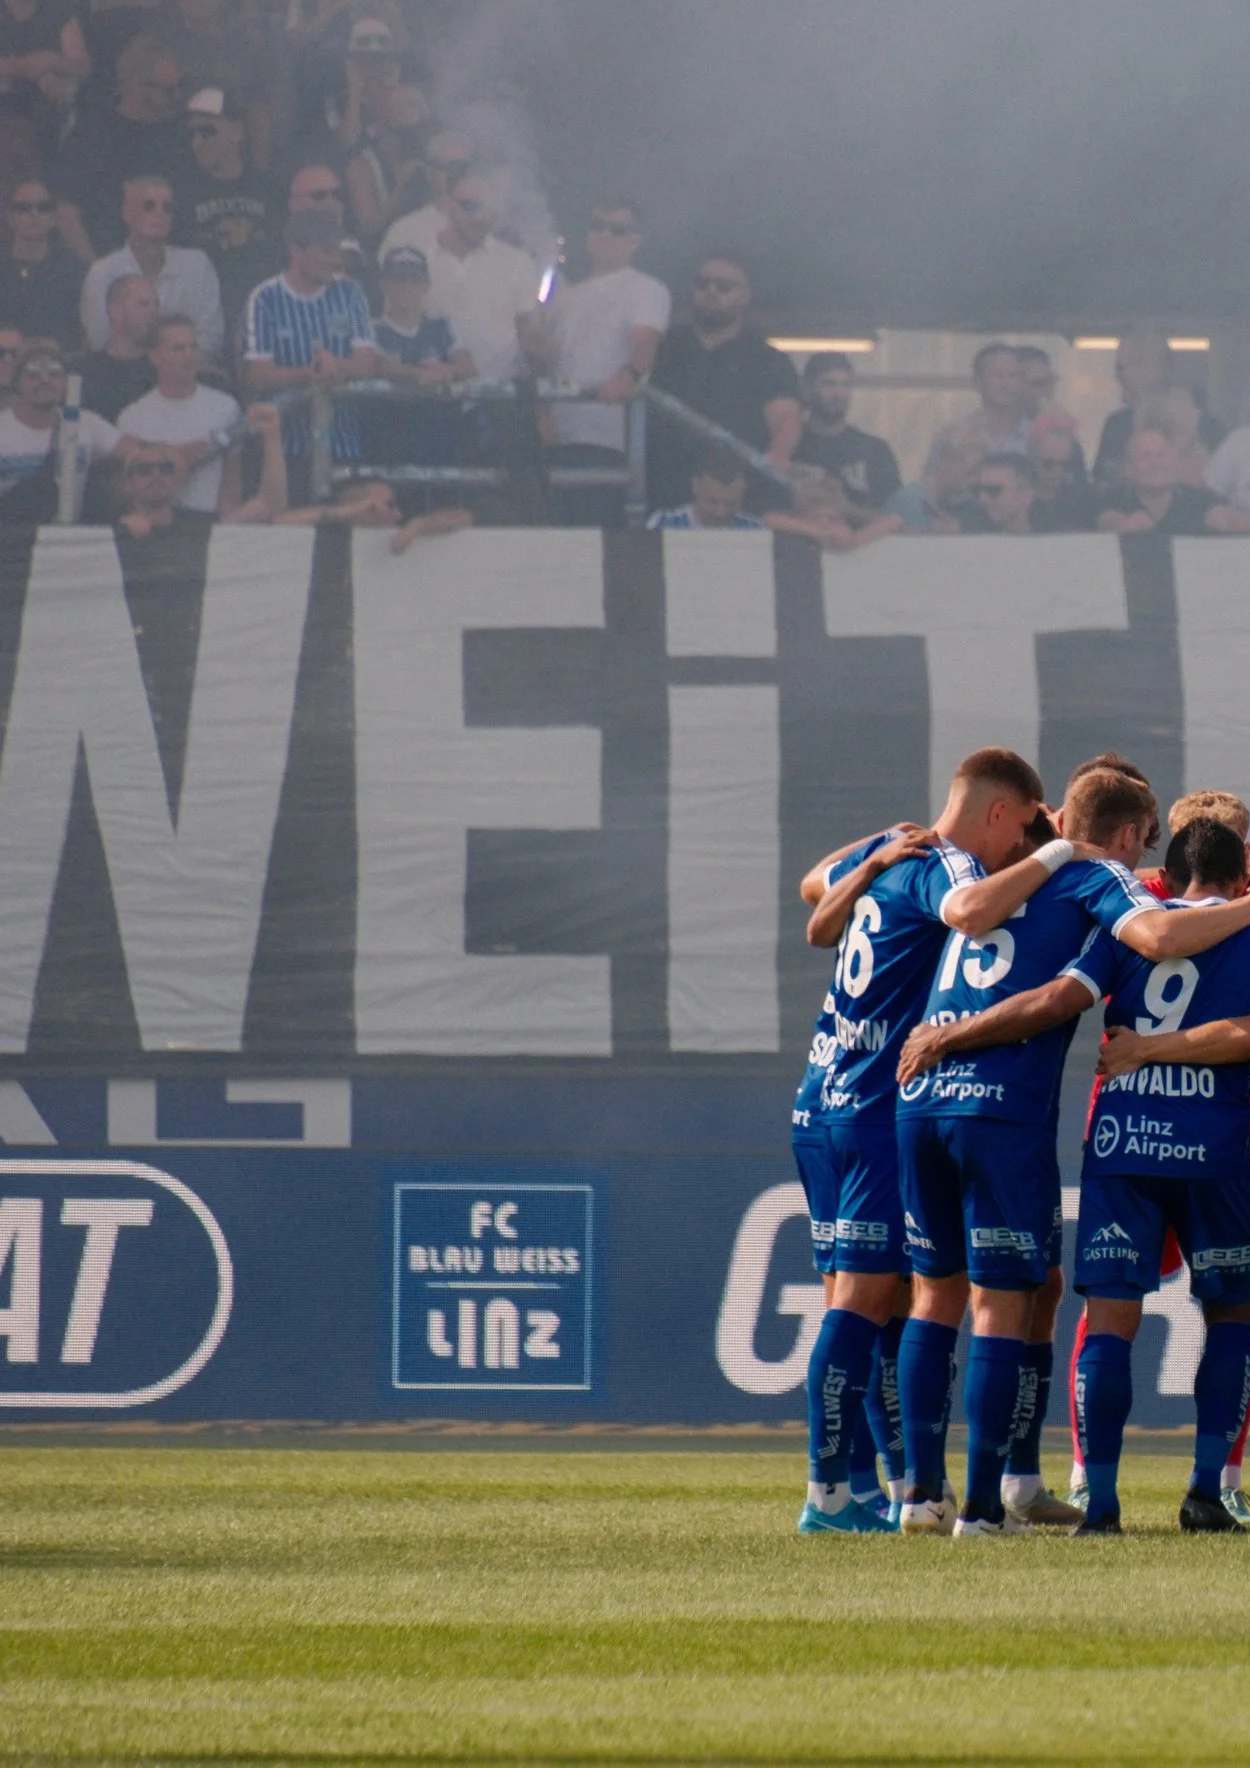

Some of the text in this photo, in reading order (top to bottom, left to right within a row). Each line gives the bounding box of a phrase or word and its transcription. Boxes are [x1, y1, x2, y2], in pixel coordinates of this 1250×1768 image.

[1135, 958, 1200, 1037] 9
[934, 1060, 977, 1079] Linz
[930, 1078, 1005, 1102] Airport
[1125, 1114, 1174, 1137] Linz
[1123, 1136, 1207, 1163] Airport
[471, 1201, 518, 1239] FC
[408, 1245, 581, 1275] BLAU WEISS
[426, 1297, 561, 1370] LINZ
[822, 1363, 848, 1432] LIWEST
